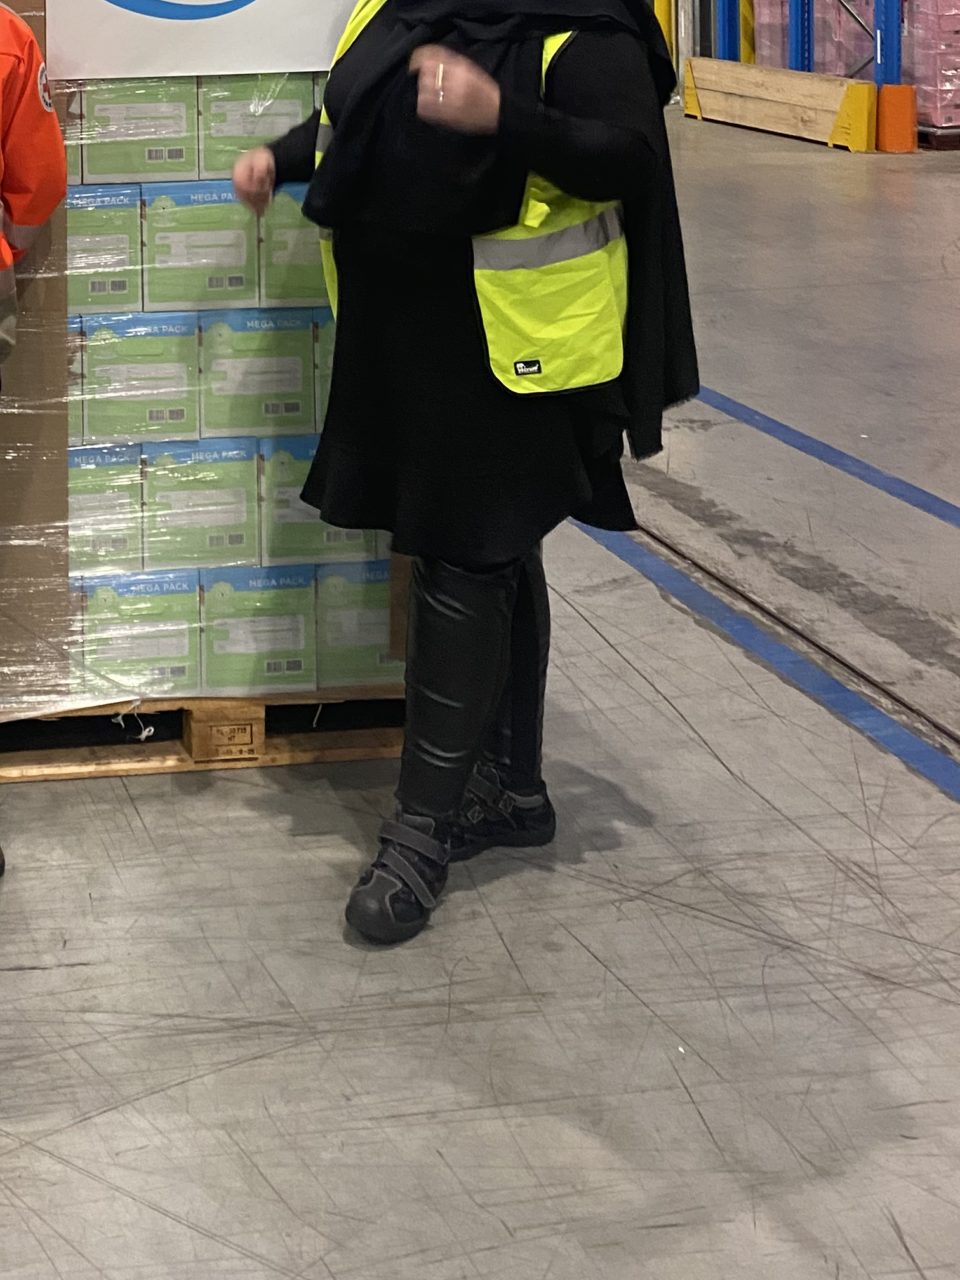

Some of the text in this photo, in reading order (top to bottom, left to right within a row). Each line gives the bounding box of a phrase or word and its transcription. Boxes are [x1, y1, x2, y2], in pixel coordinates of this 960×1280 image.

[246, 320, 274, 328] MEGA
[74, 455, 102, 464] MEGA
[191, 452, 219, 461] MEGA
[163, 582, 189, 591] PACK
[249, 578, 276, 588] MEGA
